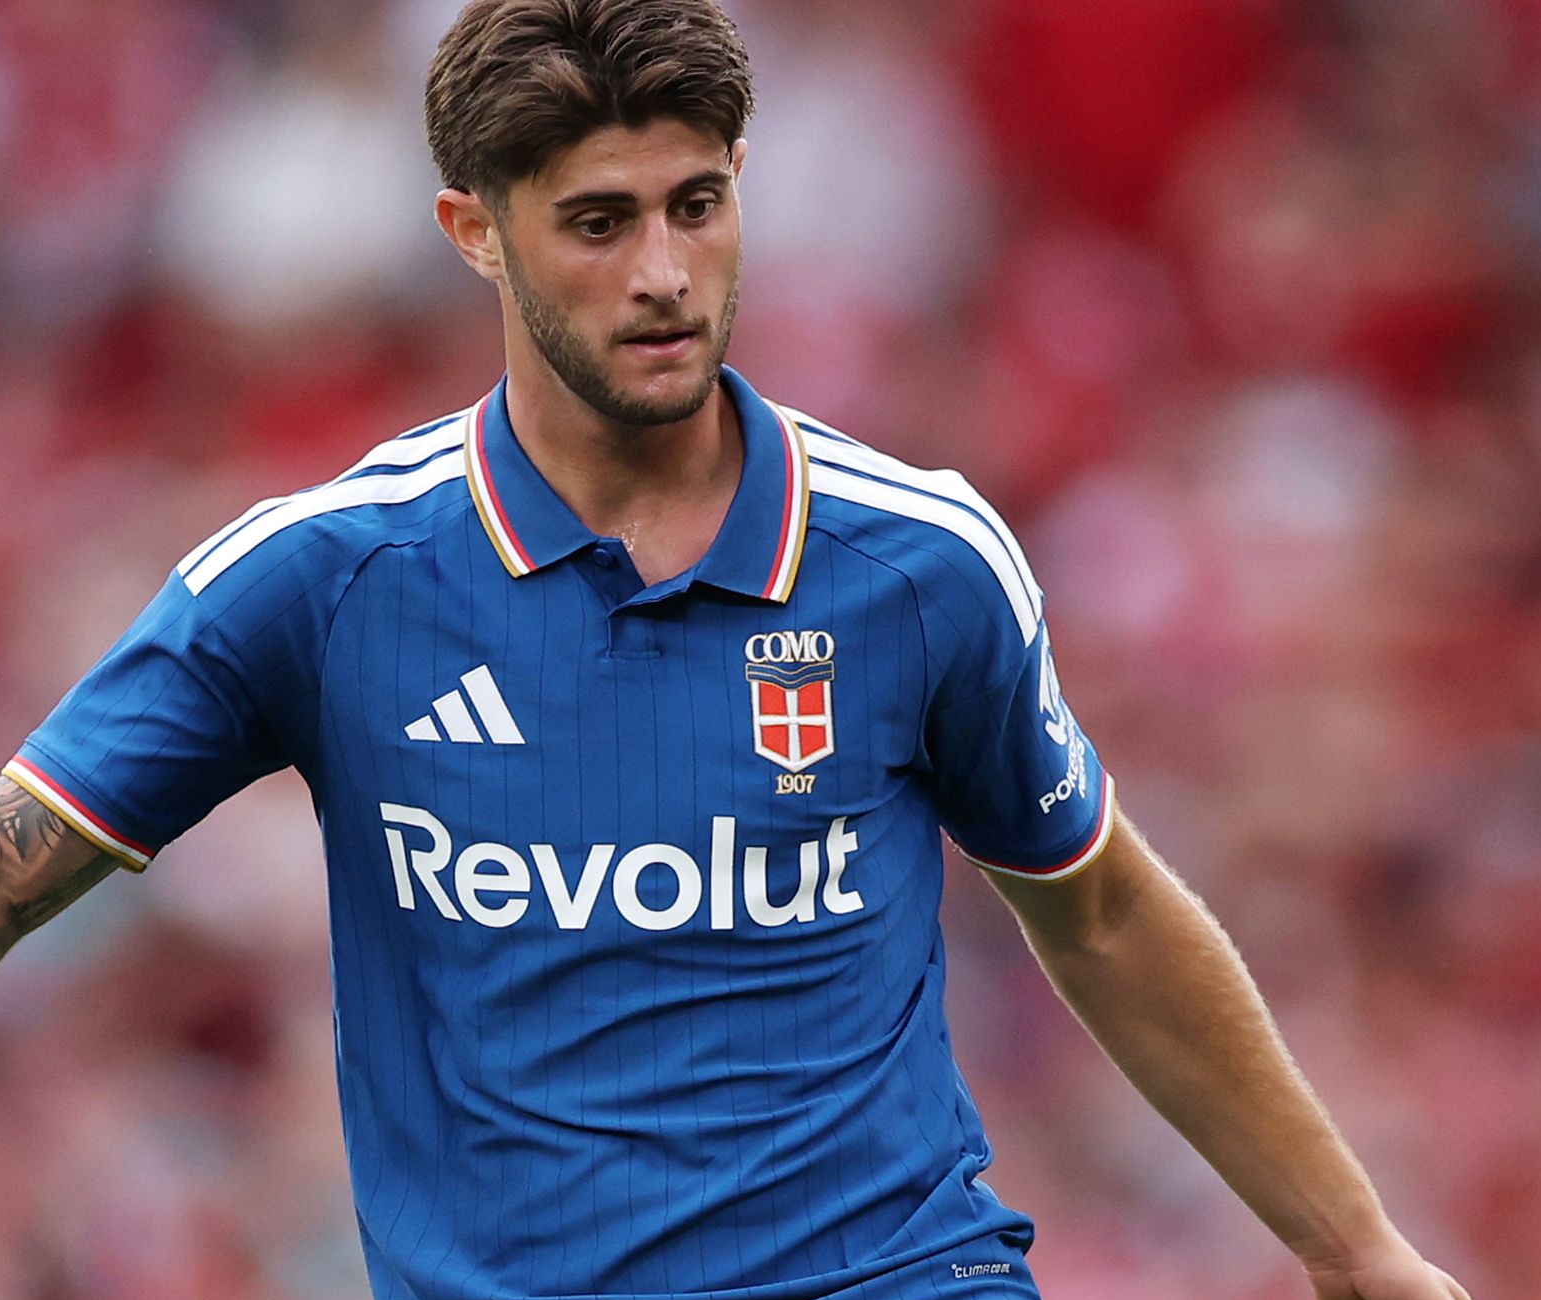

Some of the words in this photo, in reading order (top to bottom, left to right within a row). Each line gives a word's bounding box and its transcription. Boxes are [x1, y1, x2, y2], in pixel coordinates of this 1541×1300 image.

[745, 630, 835, 663] COMO
[775, 774, 817, 794] 1907
[379, 802, 864, 930] Revolut
